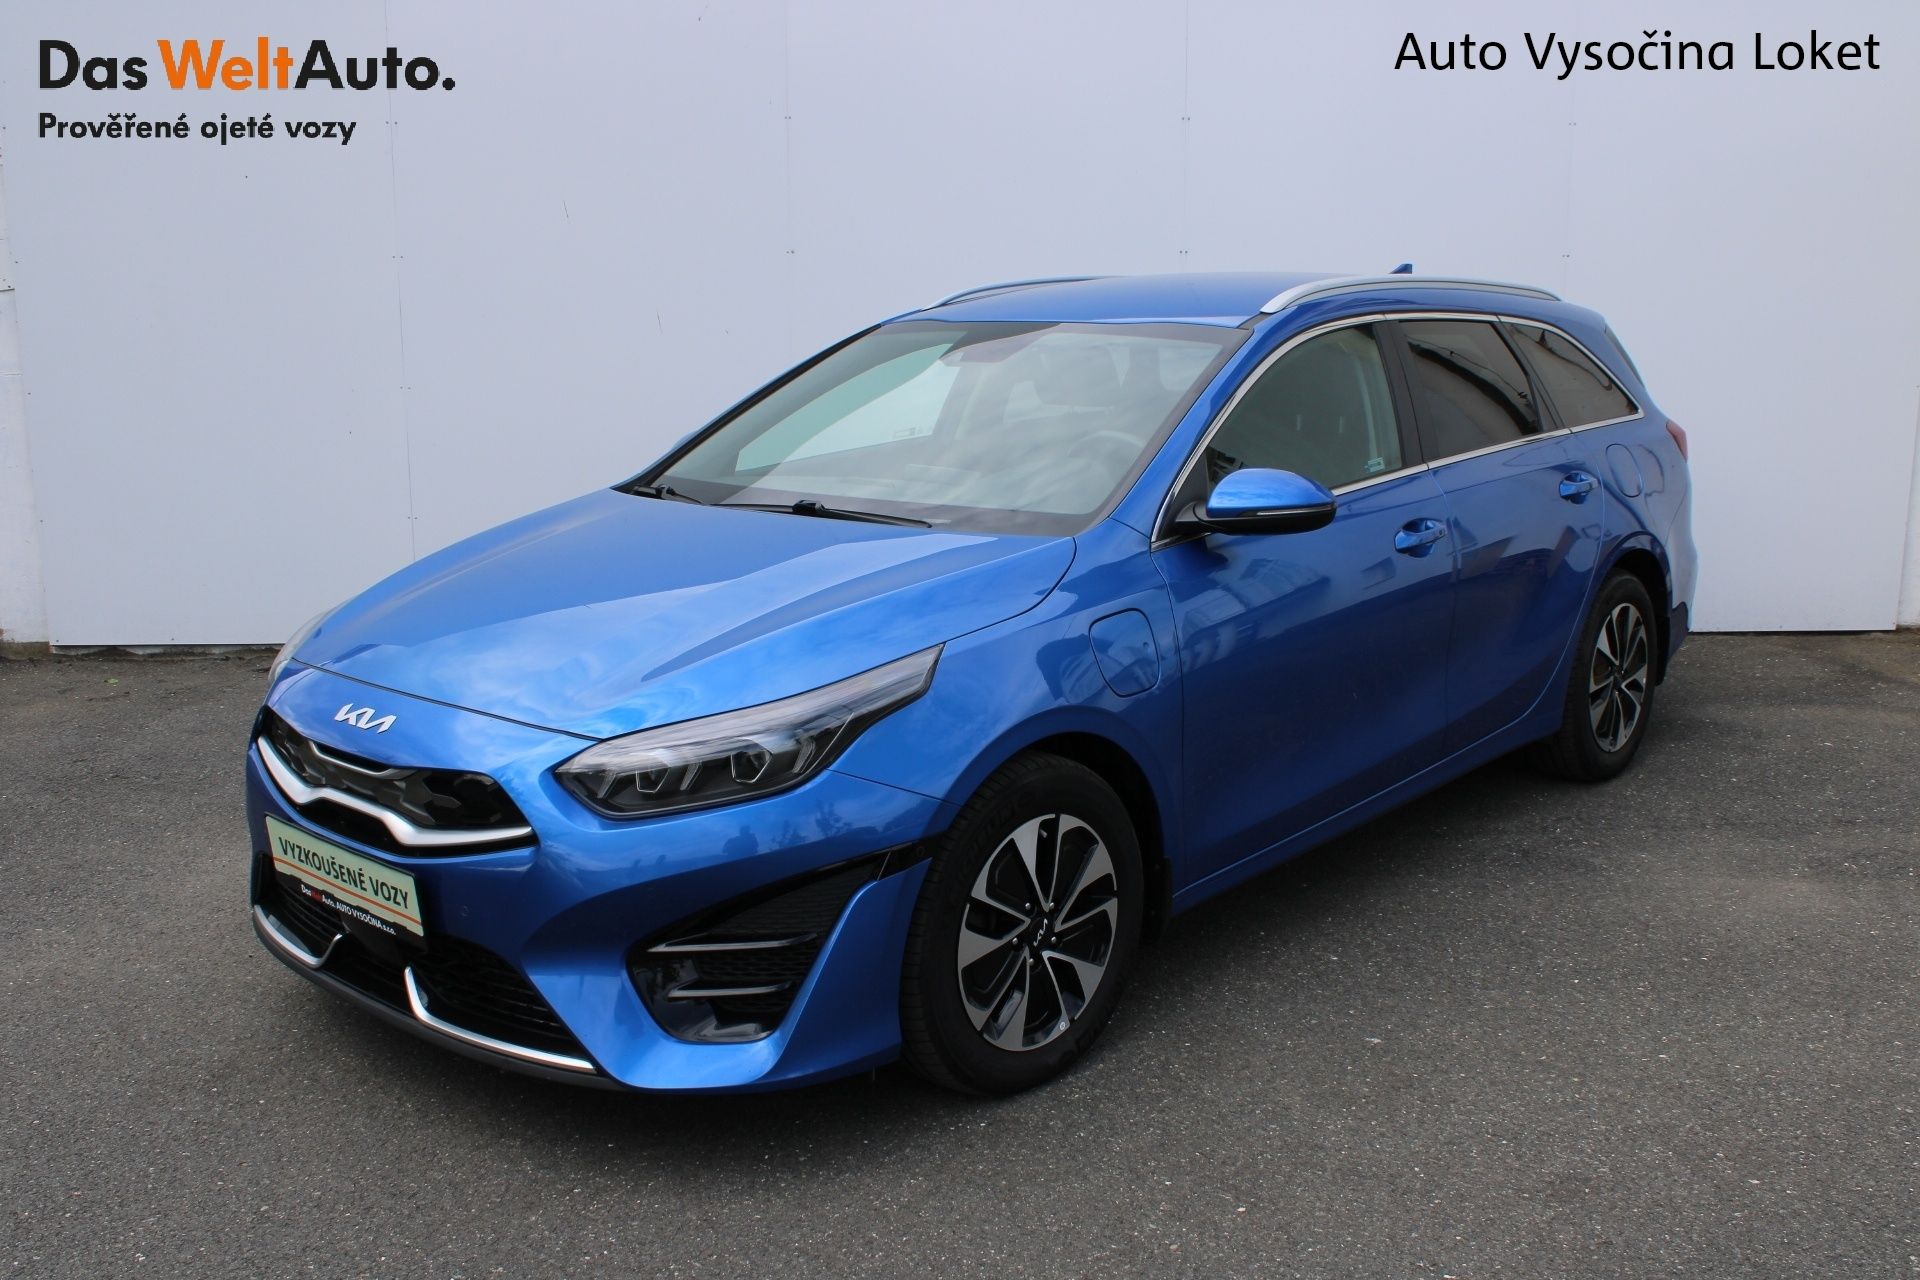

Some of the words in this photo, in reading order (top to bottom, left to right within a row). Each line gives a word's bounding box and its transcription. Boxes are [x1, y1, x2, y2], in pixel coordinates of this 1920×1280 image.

[334, 703, 397, 734] KIA
[278, 836, 367, 892] VYZKOUŠENÉ
[368, 876, 408, 909] VOZY
[336, 903, 352, 915] AUTO
